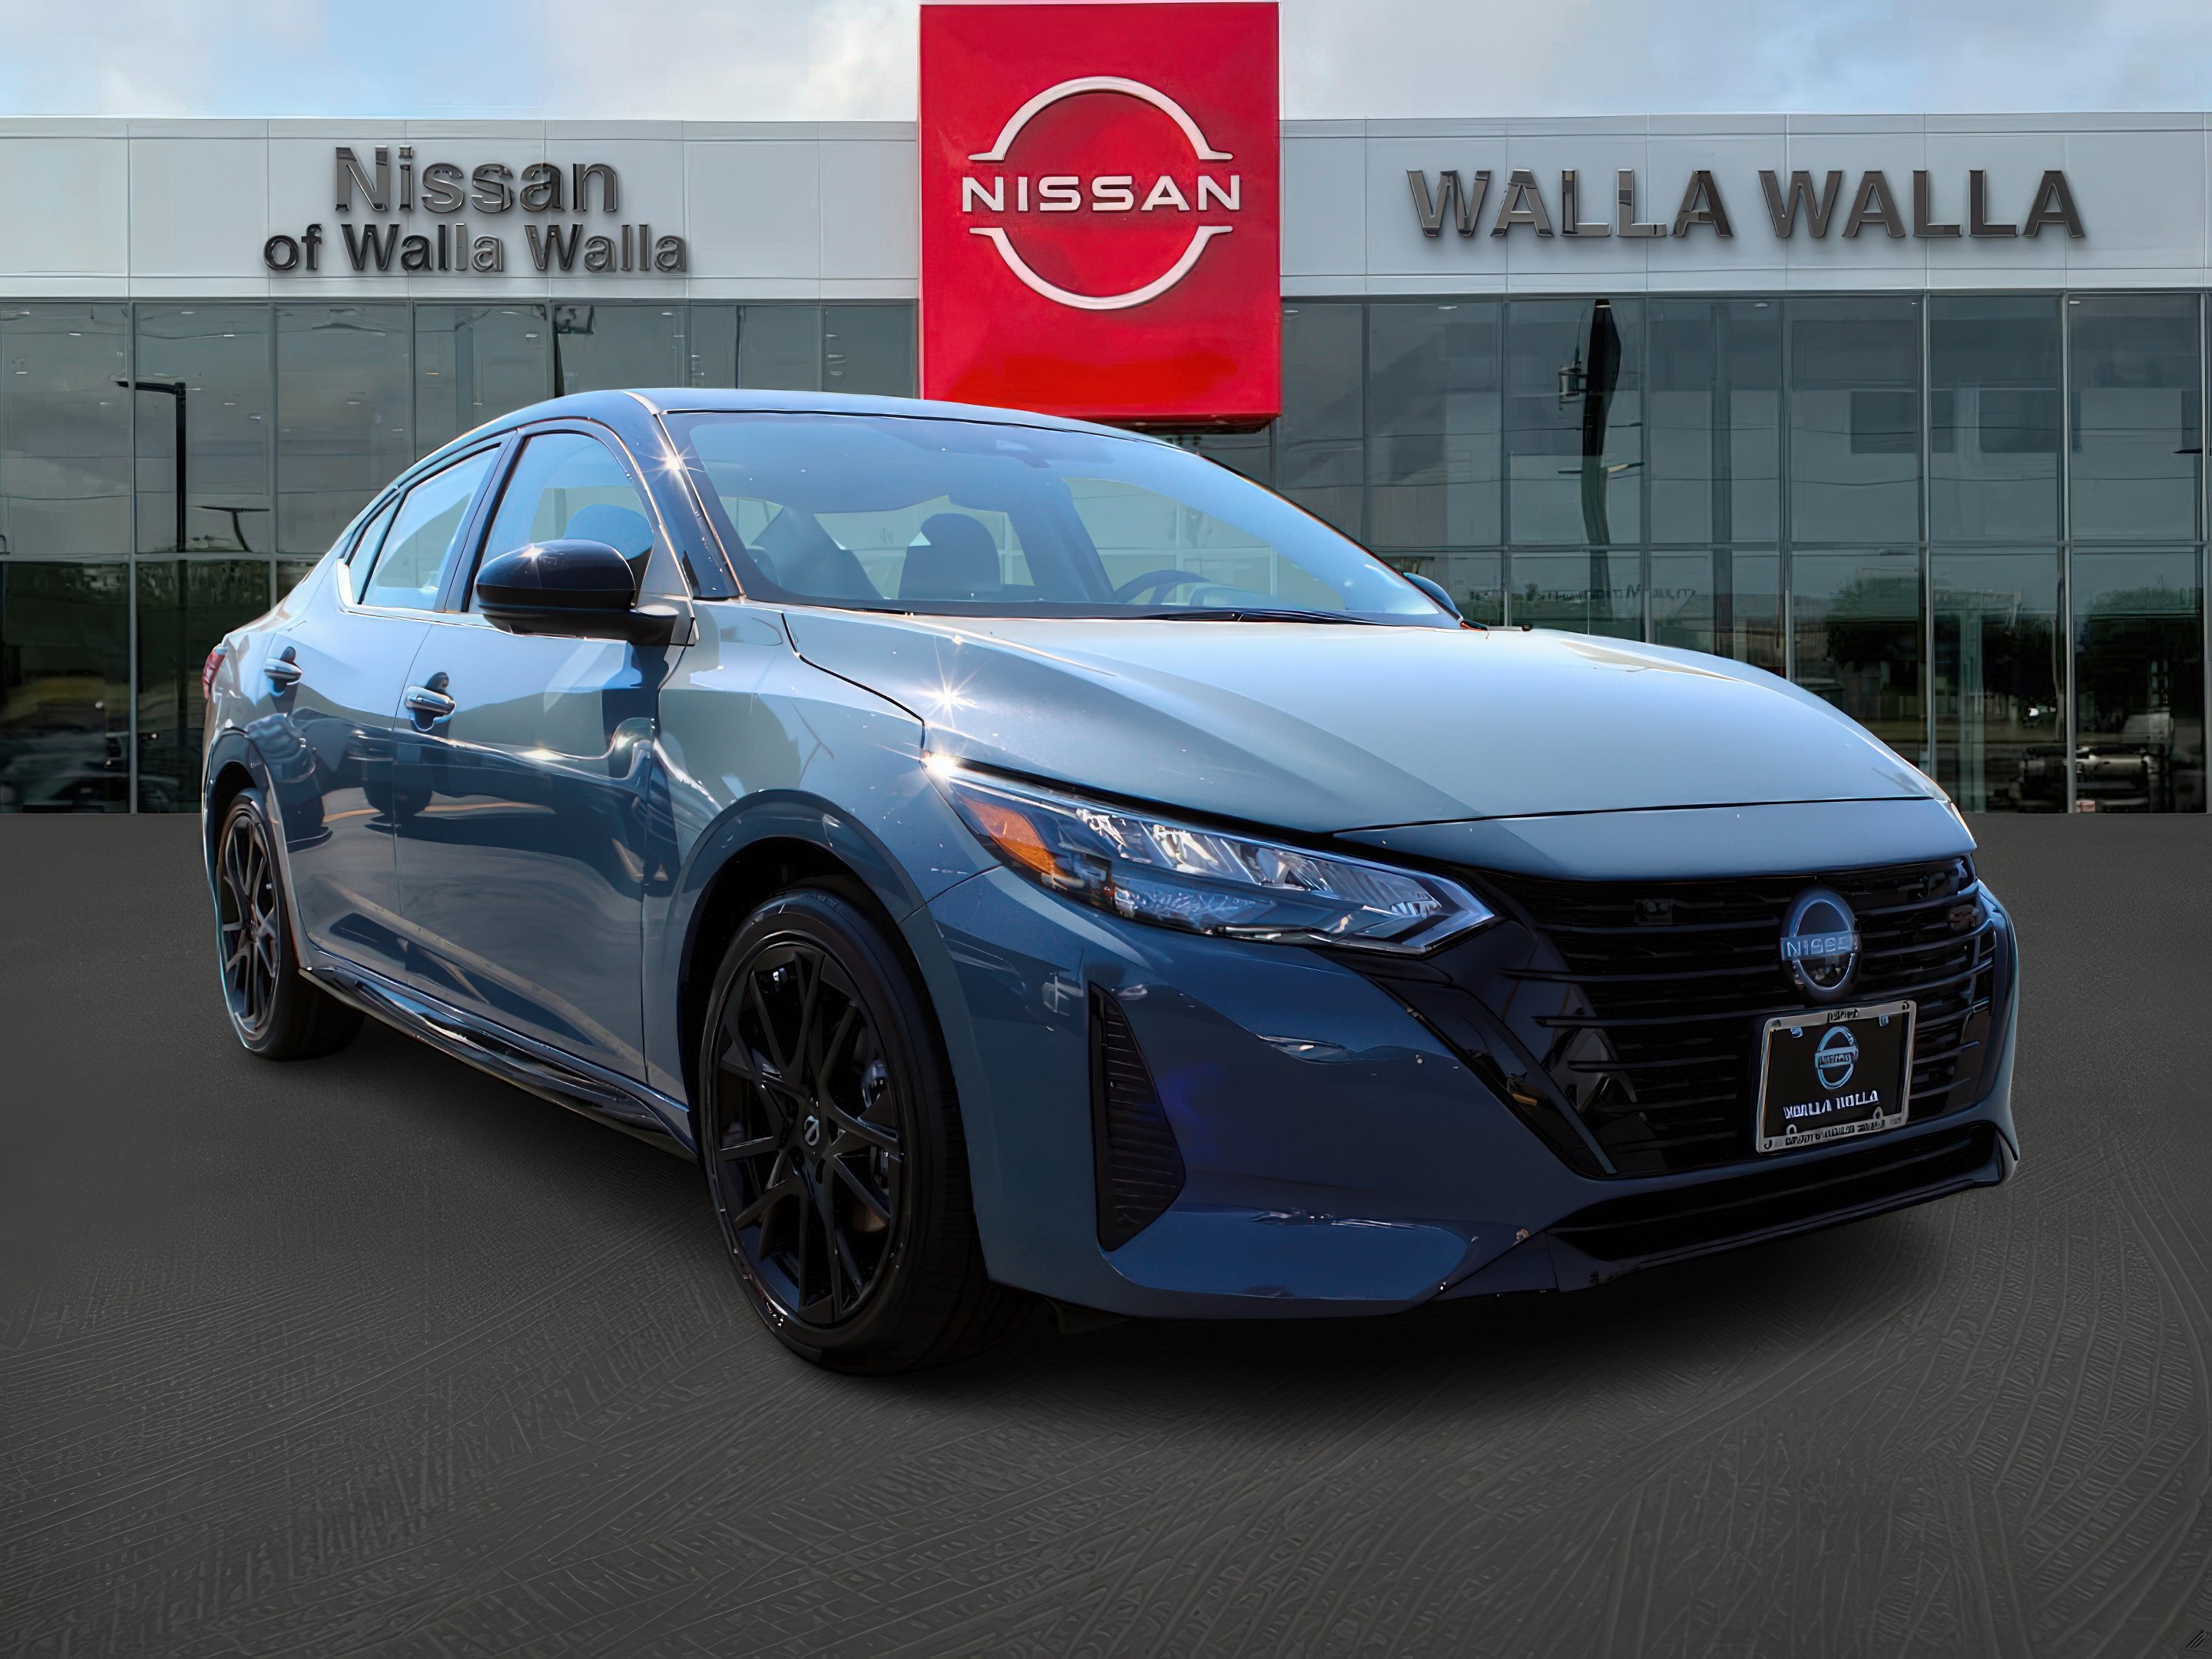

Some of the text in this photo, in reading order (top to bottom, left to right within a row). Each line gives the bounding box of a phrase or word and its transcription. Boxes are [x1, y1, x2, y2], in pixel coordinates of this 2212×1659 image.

[334, 144, 619, 213] Nissan
[962, 174, 1240, 211] NISSAN
[1406, 168, 2086, 238] WALLA WALLA
[263, 223, 687, 273] of Walla Walla
[1786, 935, 1859, 958] NISS
